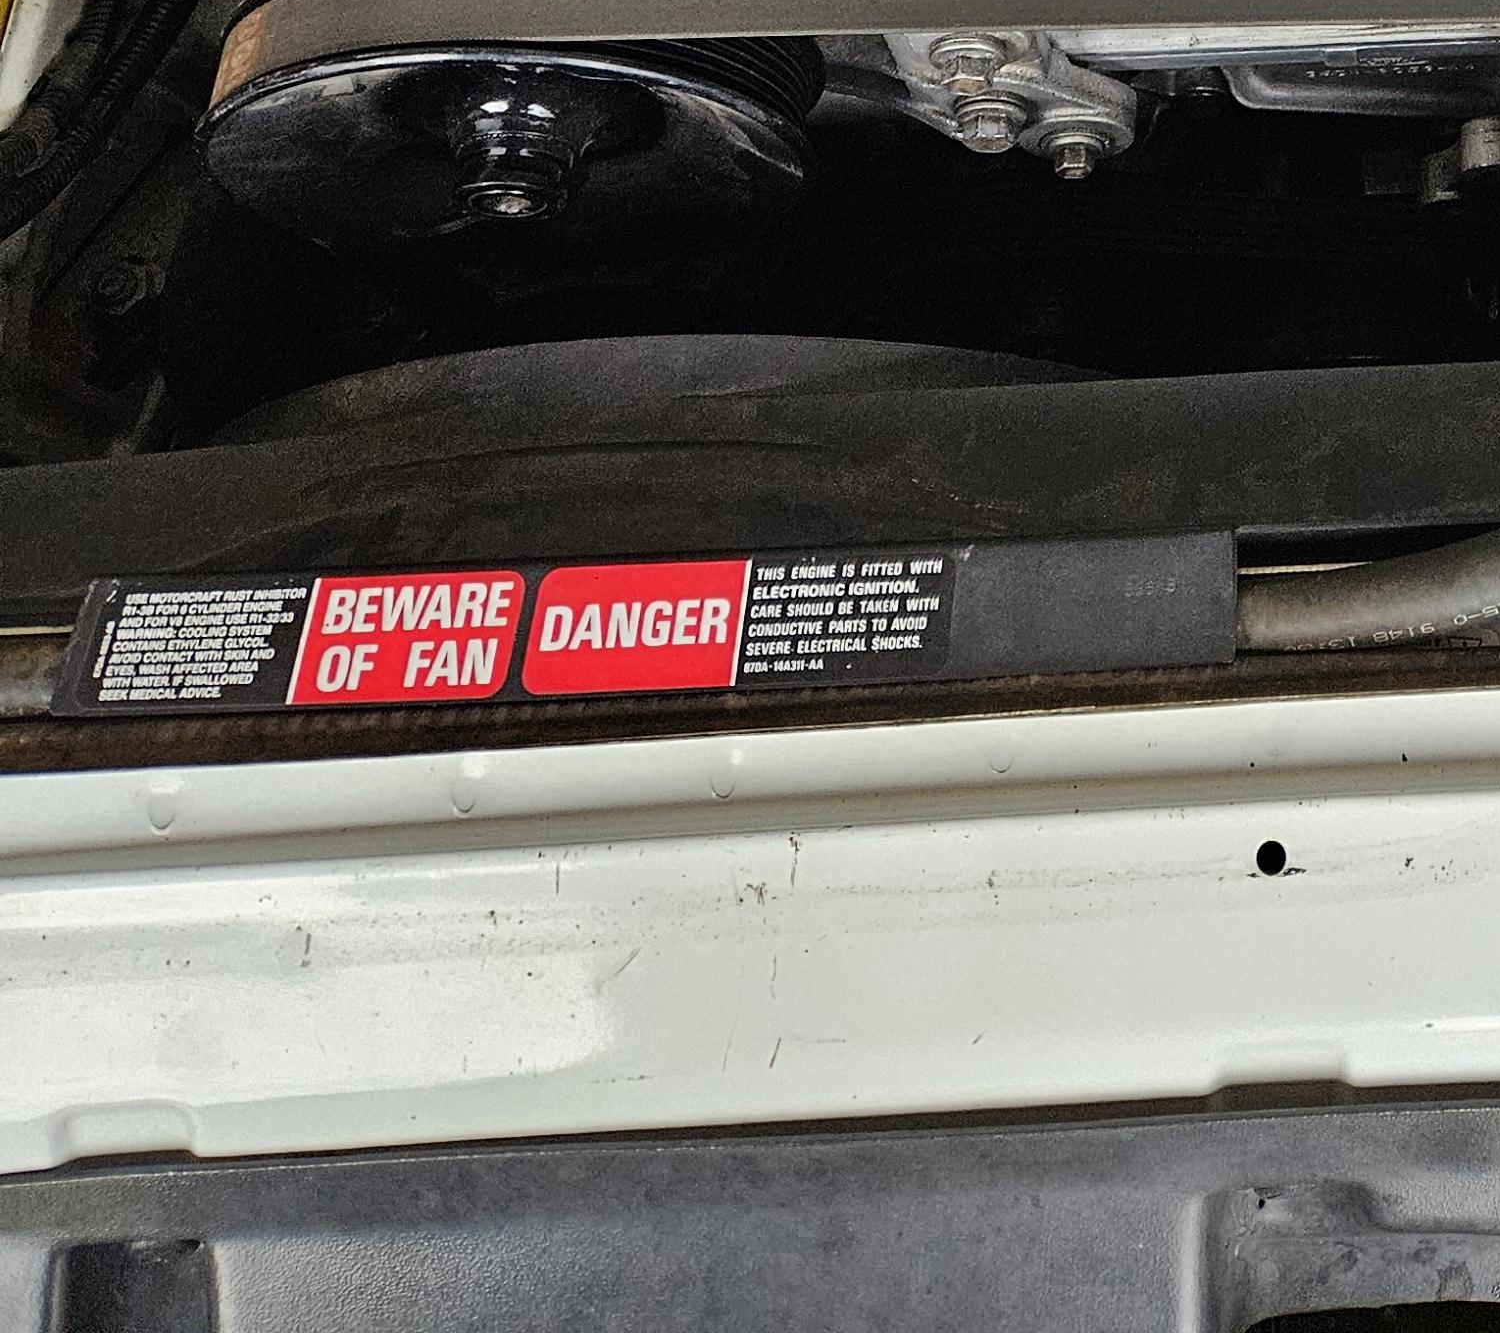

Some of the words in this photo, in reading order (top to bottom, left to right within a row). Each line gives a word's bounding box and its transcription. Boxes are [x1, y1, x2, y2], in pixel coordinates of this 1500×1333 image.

[756, 567, 785, 581] THIS
[791, 565, 836, 579] ENGINE
[842, 564, 855, 578] IS
[861, 563, 902, 577] FITTED
[909, 561, 943, 575] WITH
[125, 592, 148, 604] USE
[149, 590, 223, 603] MOTORCRAFT
[223, 590, 252, 601] RUST
[252, 587, 307, 600] INHIBITOR
[753, 583, 846, 600] ELECTRONIC
[848, 581, 920, 596] IGNITION.
[155, 603, 178, 615] FOR
[189, 601, 241, 614] CYLINDER
[242, 600, 282, 612] ENGINE
[322, 581, 515, 634] BEWARE
[750, 604, 782, 618] CARE
[787, 602, 833, 617] SHOULD
[839, 602, 854, 615] BE
[859, 600, 899, 614] TAKEN
[906, 598, 939, 612] WITH
[118, 616, 141, 628] AND
[144, 615, 166, 627] FOR
[183, 614, 224, 626] ENGINE
[225, 613, 248, 625] USE
[538, 598, 731, 652] DANGER
[748, 622, 823, 637] CONDUCTIVE
[828, 620, 866, 634] PARTS
[871, 618, 886, 633] TO
[891, 617, 928, 631] AVOID
[116, 627, 177, 640] WARNING:
[178, 626, 227, 638] COOLING
[229, 625, 273, 636] SYSTEM
[1372, 622, 1435, 643] 9148
[112, 640, 167, 652] CONTAINS
[169, 638, 222, 650] ETHYLENE
[223, 637, 268, 649] GLYCOL.
[746, 641, 791, 656] SEVERE
[797, 638, 866, 654] ELECTRICAL
[871, 636, 923, 652] SHOCKS.
[109, 652, 142, 664] AVOID
[144, 651, 194, 663] CONTACT
[195, 650, 223, 661] WITH
[224, 649, 248, 661] SKIN
[249, 649, 275, 660] AND
[316, 644, 377, 693] OF
[403, 638, 498, 688] FAN
[106, 664, 135, 677] EYES,
[138, 663, 168, 676] WASH
[169, 662, 225, 674] AFFECTED
[227, 661, 259, 673] AREA
[103, 676, 130, 688] WITH
[172, 675, 183, 686] IF
[184, 674, 254, 686] SWALLOWED
[99, 688, 129, 701] SEEK
[130, 688, 177, 700] MEDICAL
[179, 686, 221, 698] ADVICE.
